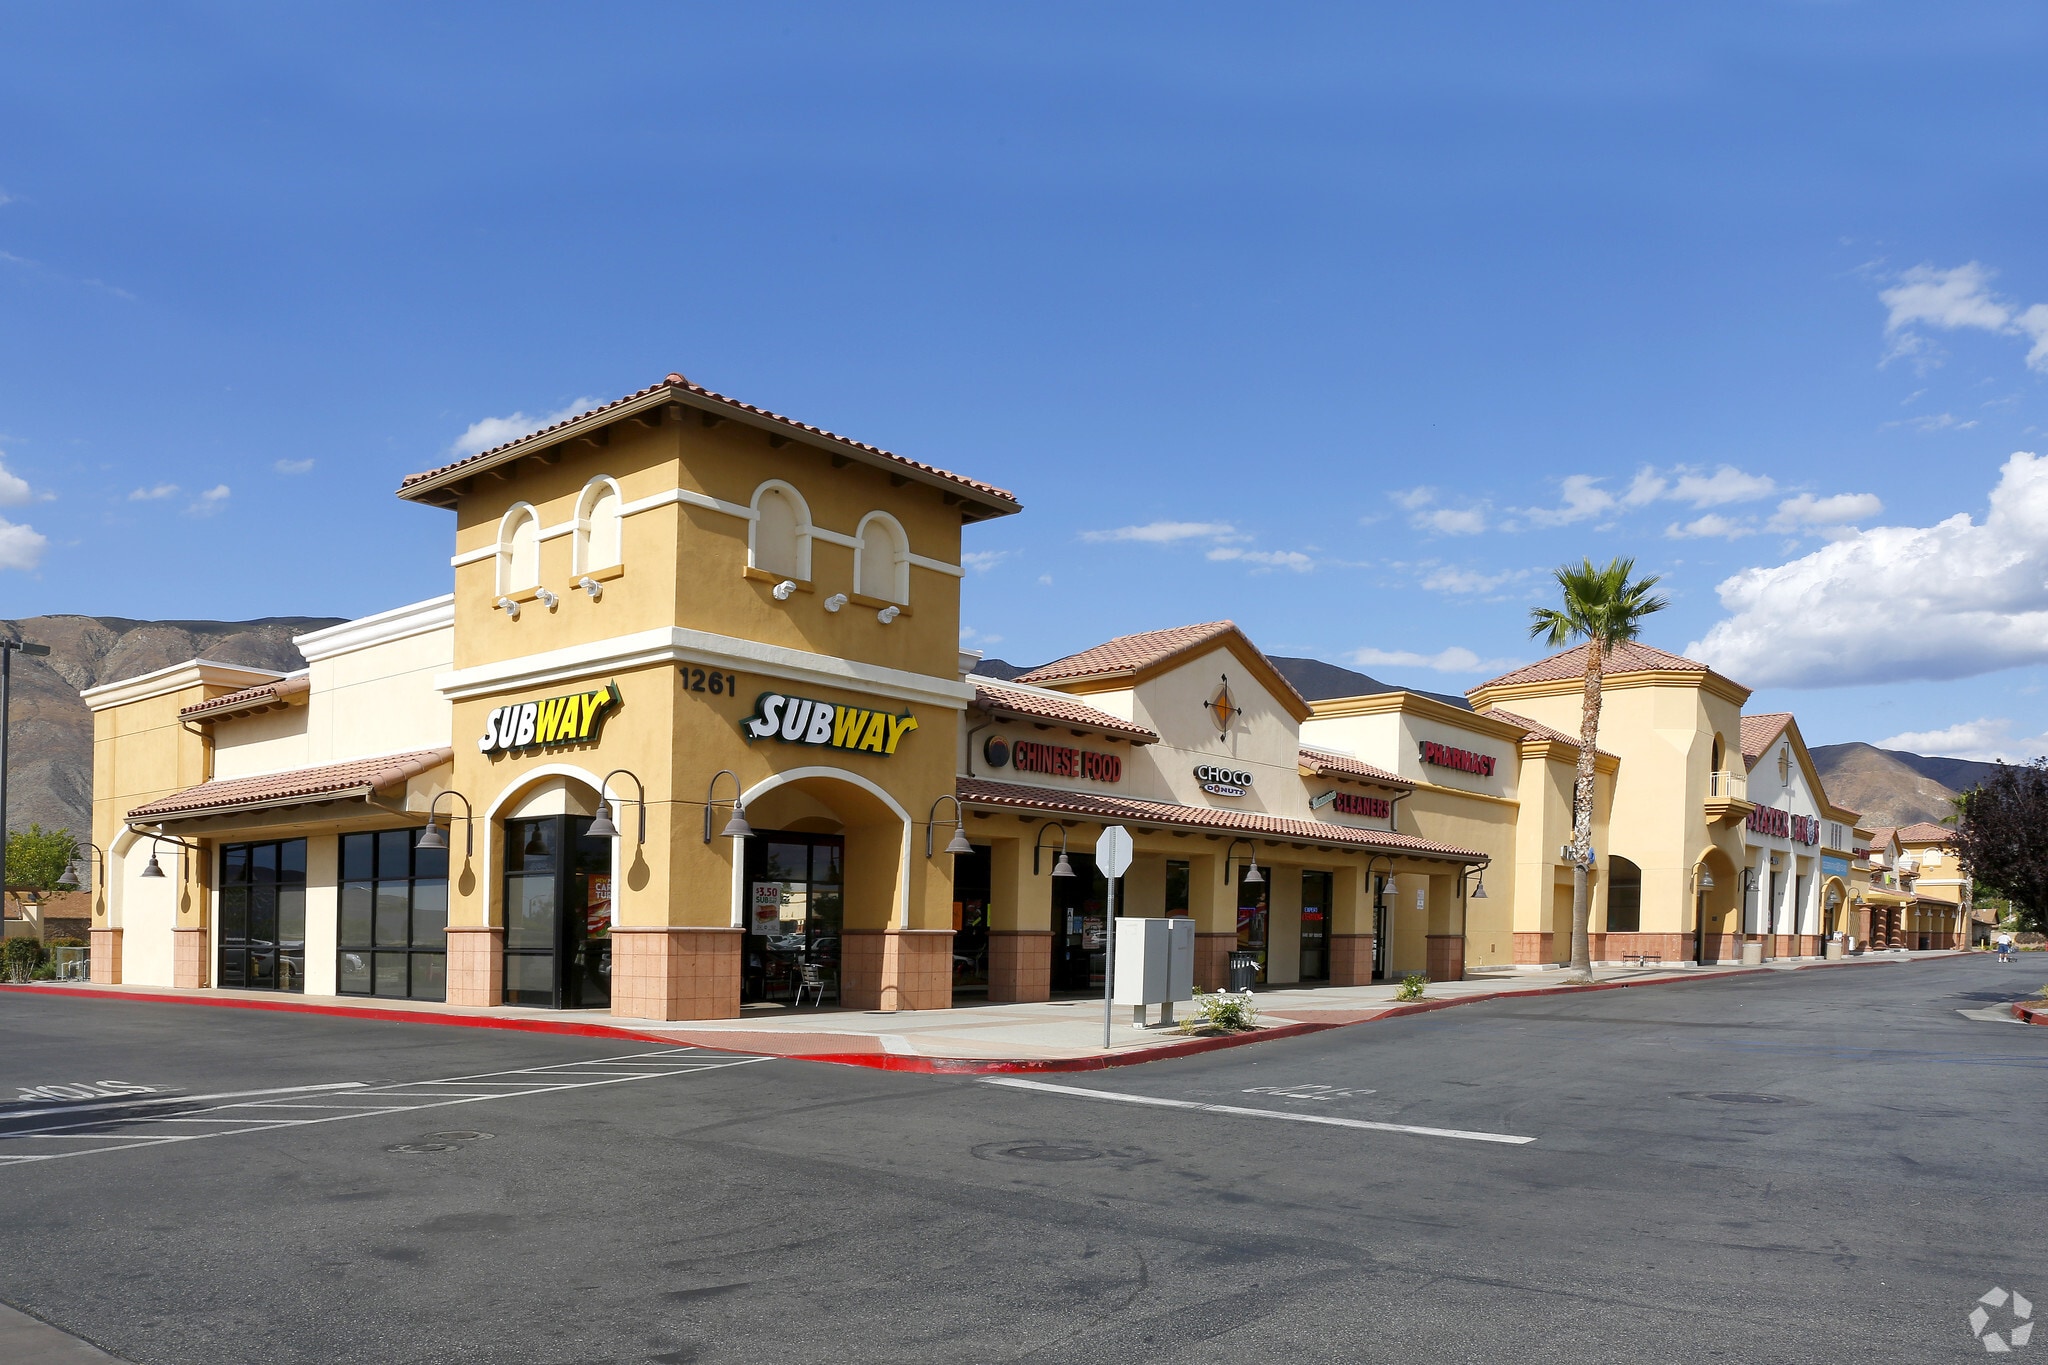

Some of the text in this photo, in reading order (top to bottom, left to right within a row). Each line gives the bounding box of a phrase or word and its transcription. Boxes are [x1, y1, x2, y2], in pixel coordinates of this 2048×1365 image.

[679, 667, 736, 697] 1261
[477, 684, 611, 755] SUBWAY
[749, 693, 919, 755] SUBWAY
[1015, 741, 1122, 783] CHINESE FOOD
[1425, 741, 1497, 777] PHARMACY
[1197, 765, 1253, 787] CHOCO
[1206, 784, 1244, 795] DONUTS
[1336, 793, 1390, 819] CLEANERS
[755, 887, 778, 897] $3.50
[15, 1079, 157, 1103] STOP
